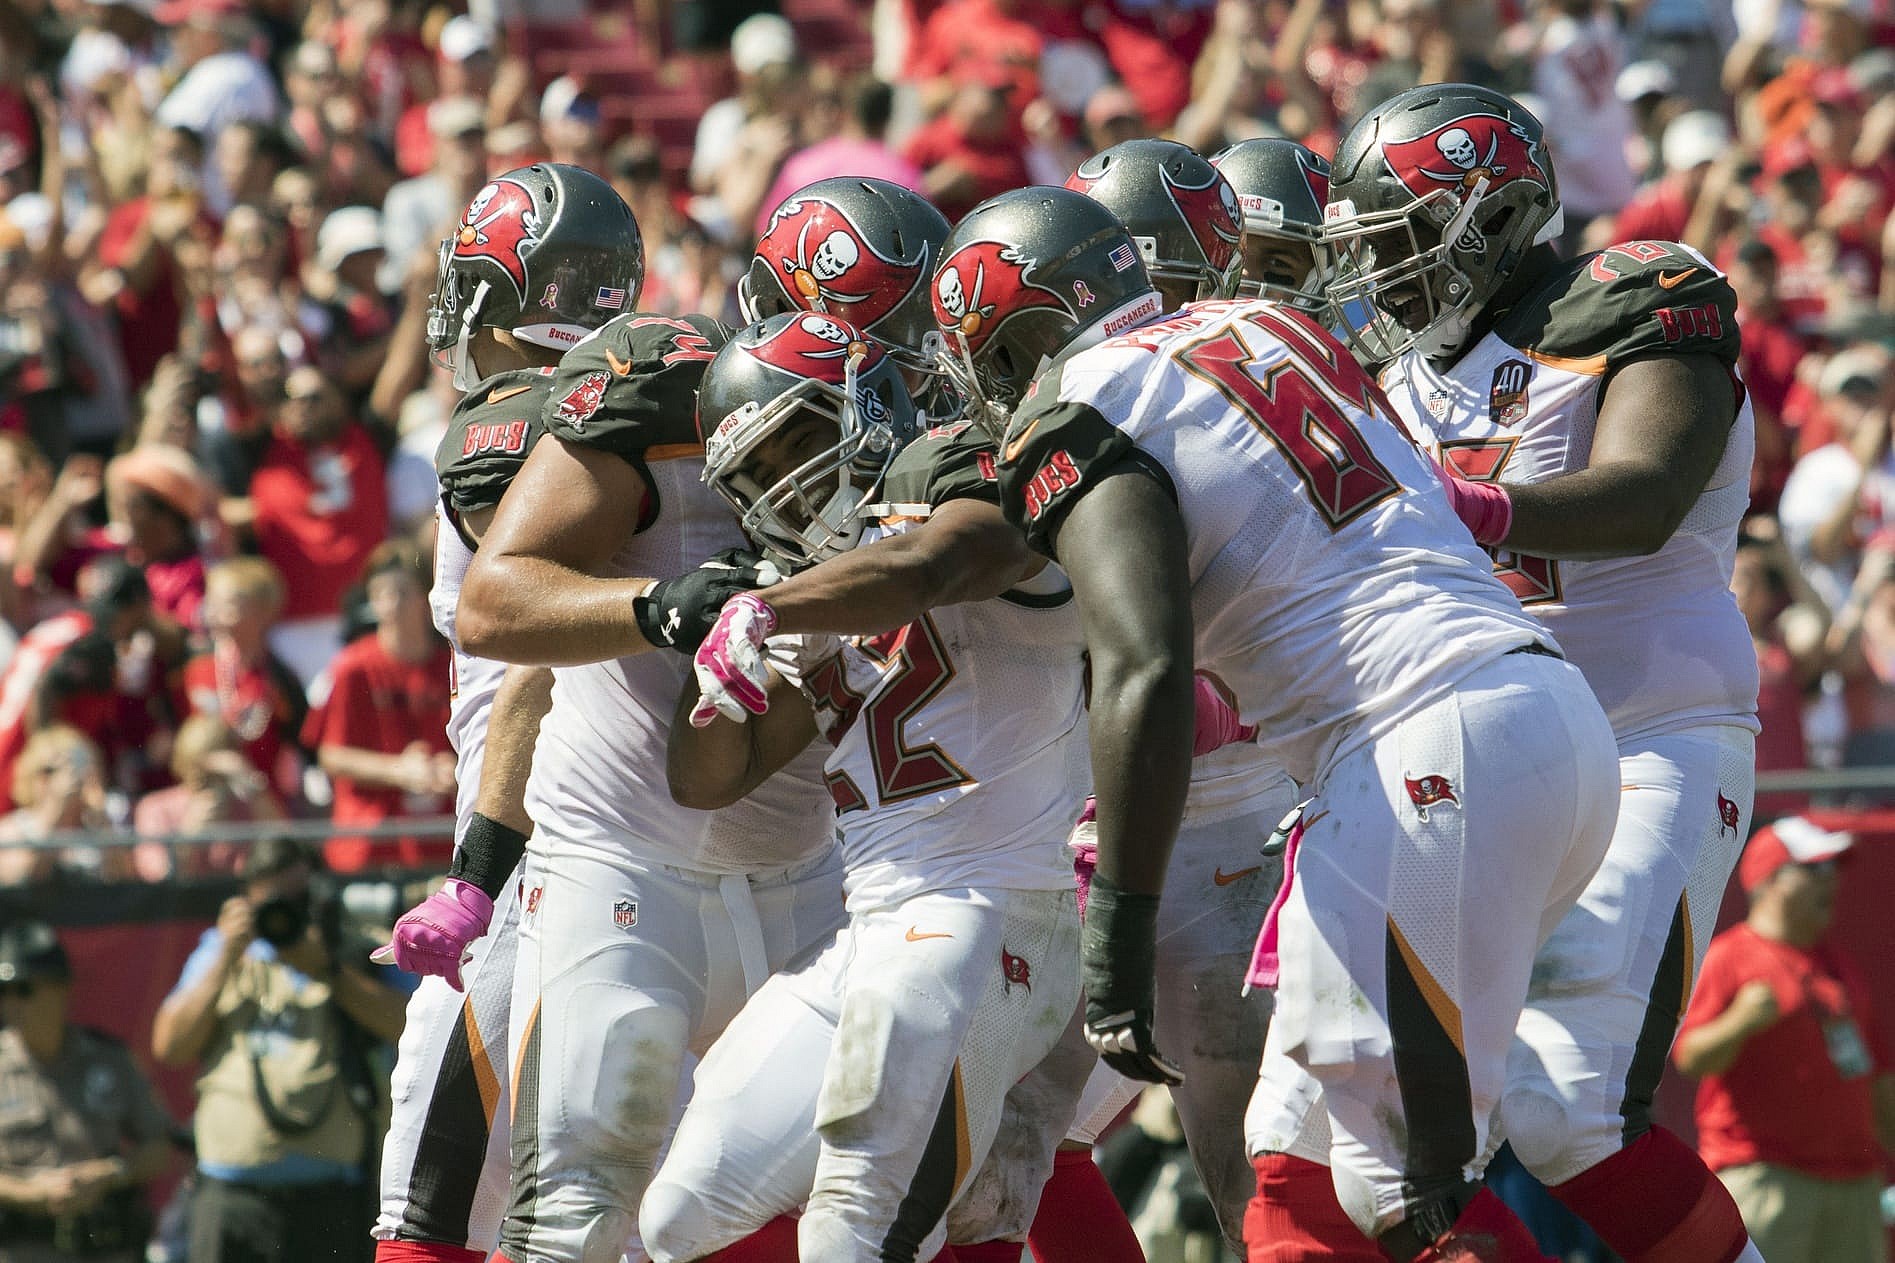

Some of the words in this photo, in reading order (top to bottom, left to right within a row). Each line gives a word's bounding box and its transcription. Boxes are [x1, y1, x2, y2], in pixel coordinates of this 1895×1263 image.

[548, 327, 586, 343] BUCCAN
[1103, 298, 1156, 337] BUCCANEERS
[1655, 303, 1722, 344] BUCS
[1496, 365, 1524, 394] 40
[463, 419, 529, 459] BUCS
[720, 415, 739, 437] BUCS
[1021, 450, 1082, 522] BUCS
